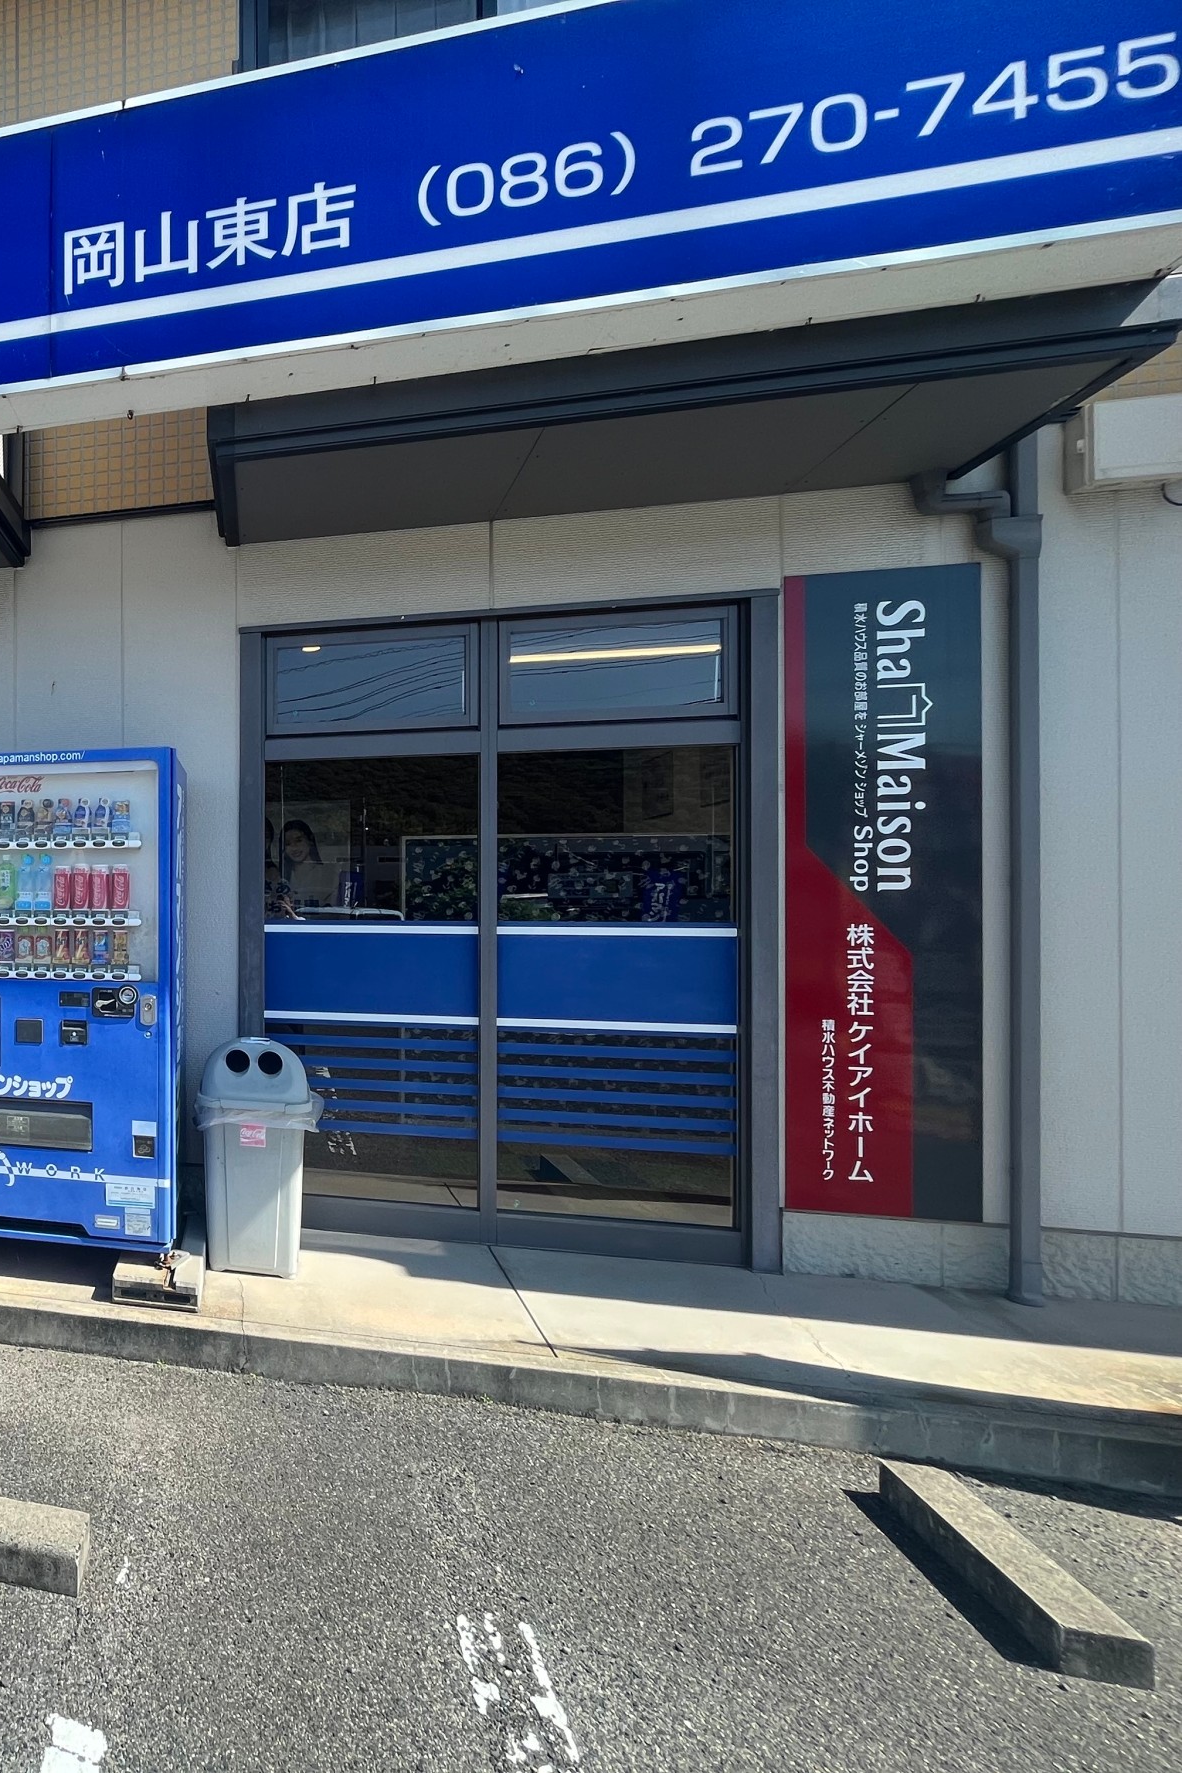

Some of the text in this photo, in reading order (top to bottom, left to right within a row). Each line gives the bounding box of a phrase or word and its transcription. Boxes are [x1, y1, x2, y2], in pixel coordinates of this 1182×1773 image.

[418, 31, 1181, 226] (086) 270-7455
[63, 182, 357, 295] 岡山東店
[875, 599, 927, 893] Sha Maison
[849, 825, 874, 892] Shop
[820, 1018, 836, 1181] 積水ハウス不動産ネットワーク
[846, 923, 876, 1184] 株式会社ケイアイホーム
